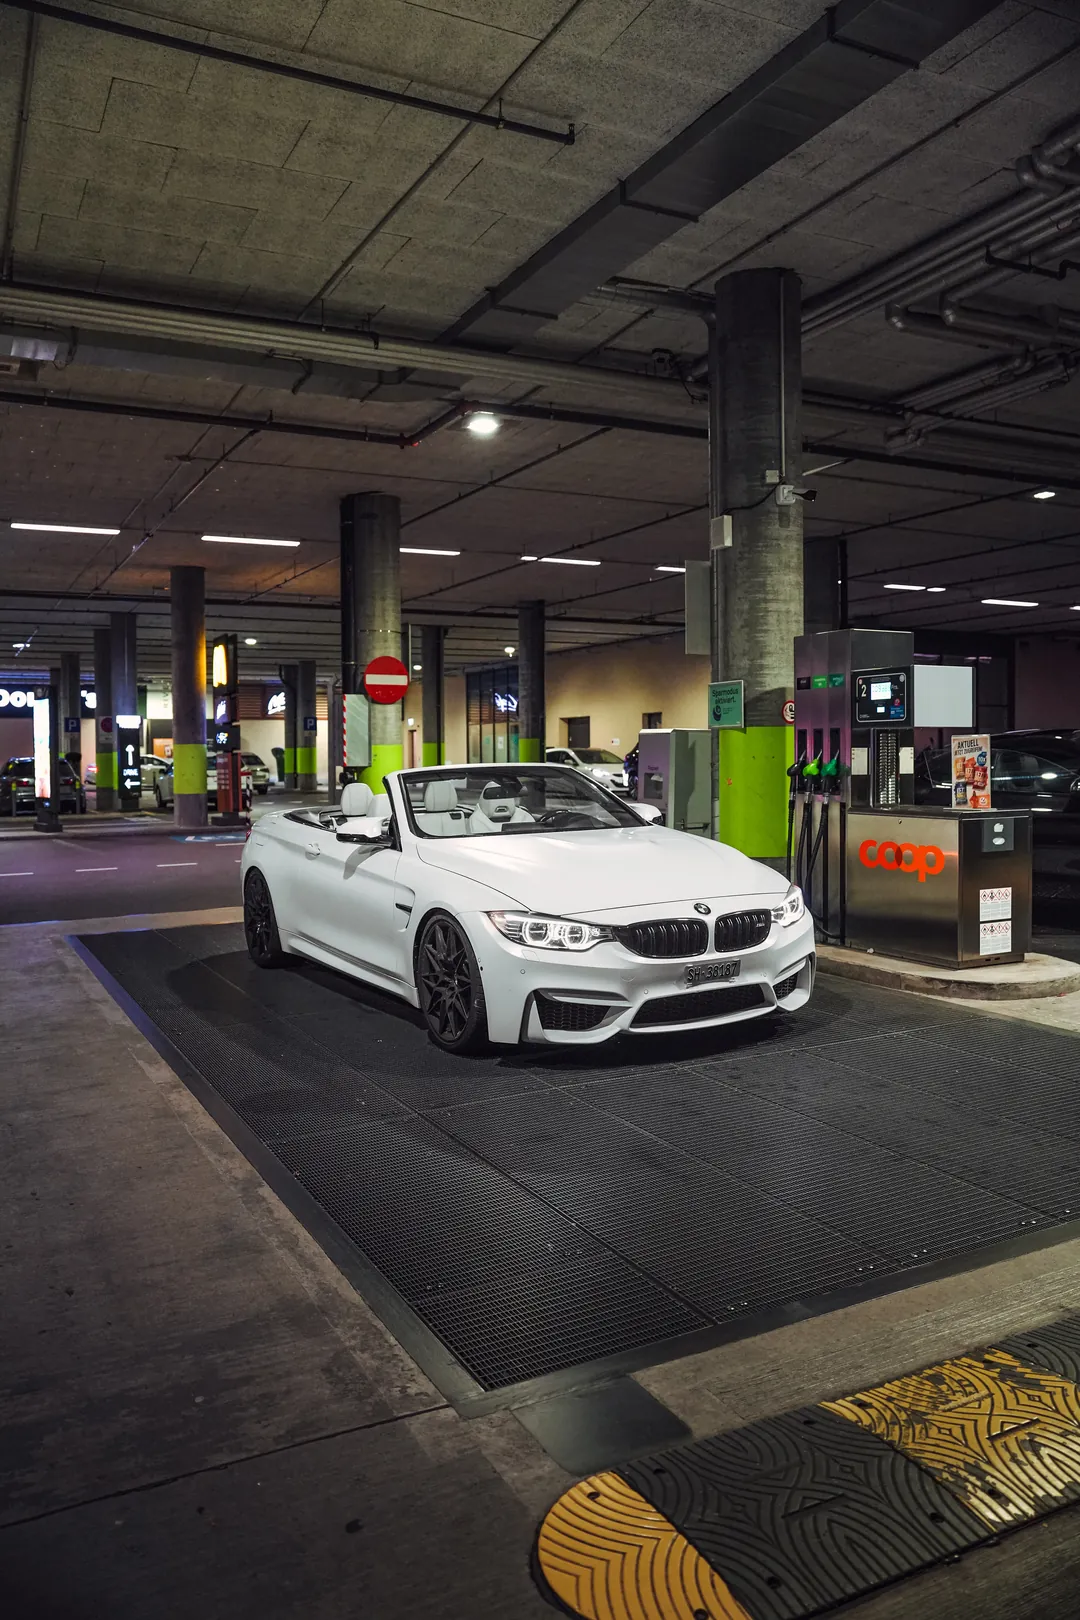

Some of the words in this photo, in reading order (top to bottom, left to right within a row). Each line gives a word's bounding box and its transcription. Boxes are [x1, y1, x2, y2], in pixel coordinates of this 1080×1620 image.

[712, 687, 739, 698] Sparmodus
[861, 684, 867, 697] 2
[68, 720, 77, 730] P
[307, 718, 314, 729] P
[957, 739, 979, 749] AKTUELL
[859, 839, 945, 883] coop
